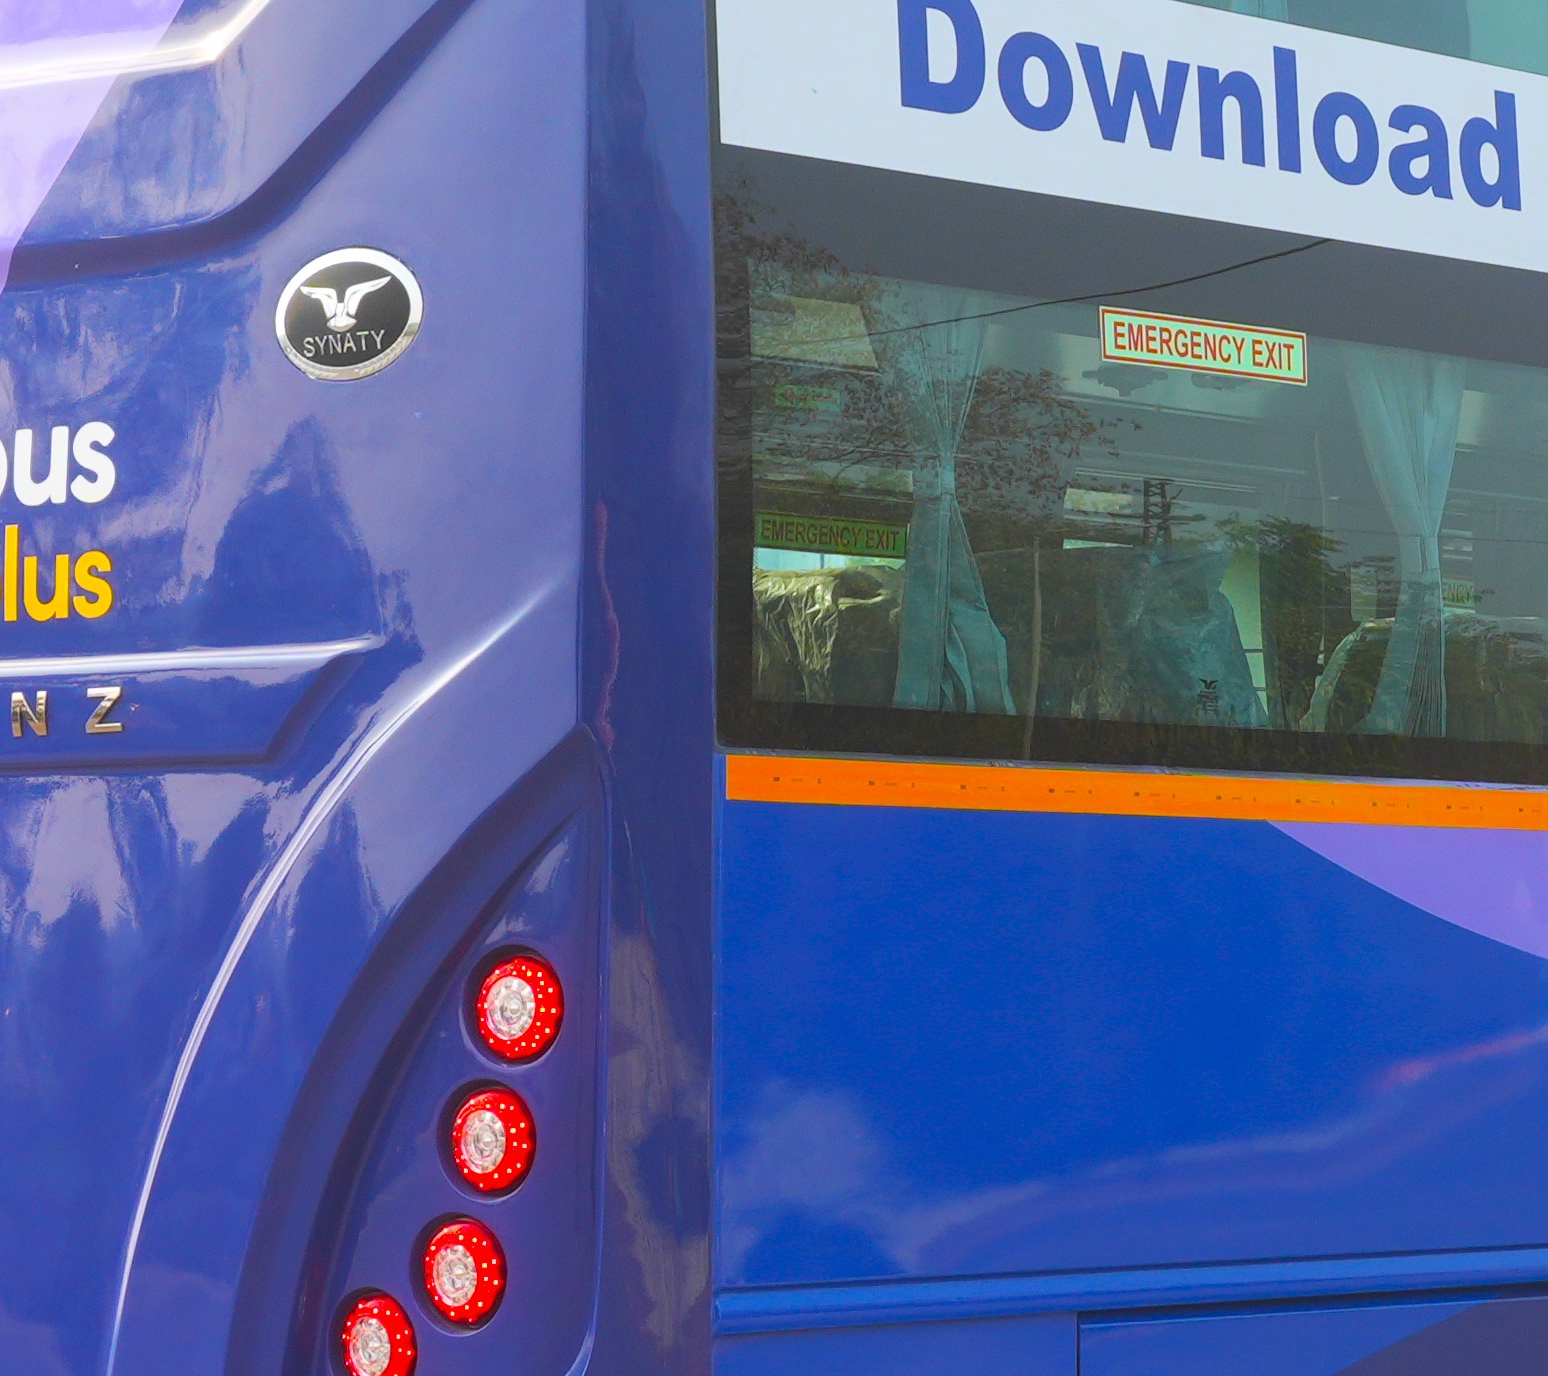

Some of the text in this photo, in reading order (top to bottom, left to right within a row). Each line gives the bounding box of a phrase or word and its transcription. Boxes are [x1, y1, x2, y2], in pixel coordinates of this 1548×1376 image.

[302, 329, 386, 359] SYNATY
[1114, 321, 1294, 371] EMERGENCY EXIT
[761, 519, 900, 551] EMERGENCY EXIT
